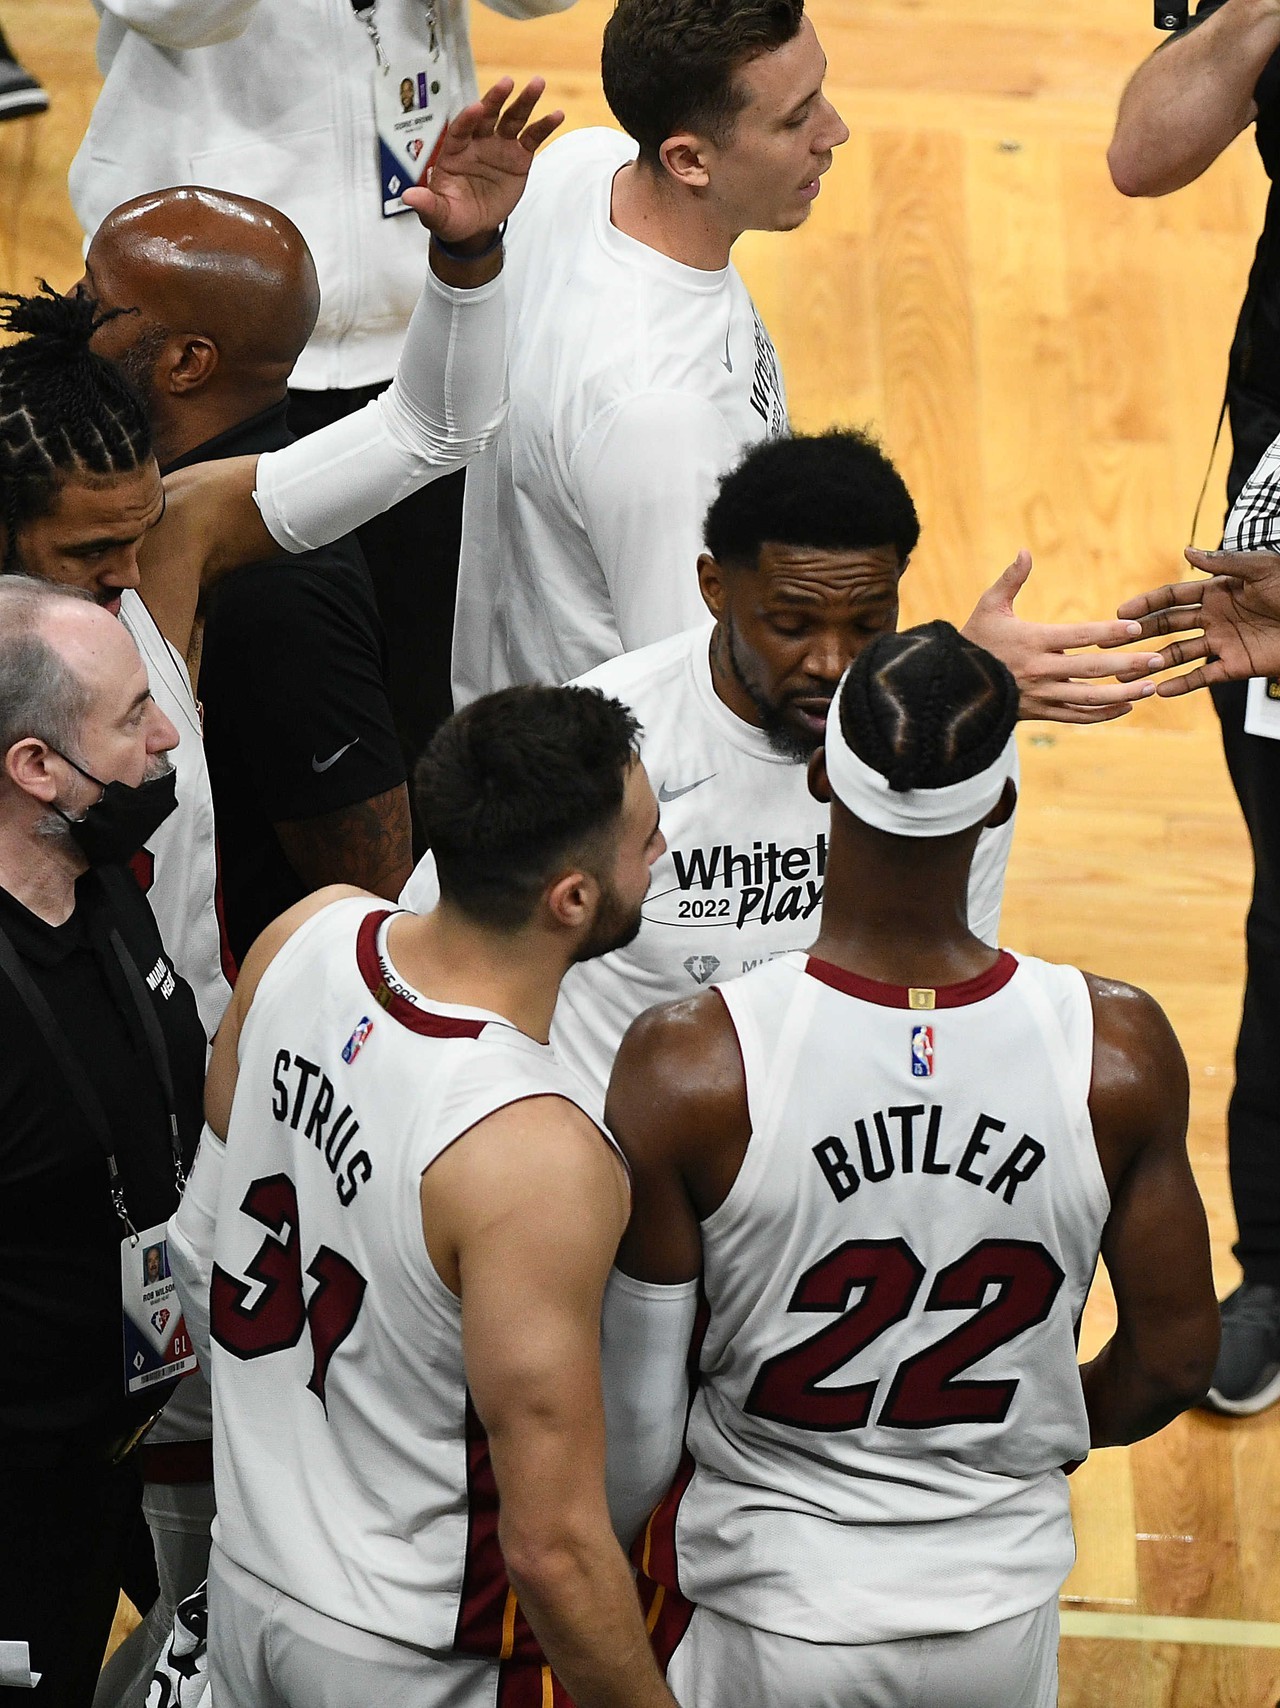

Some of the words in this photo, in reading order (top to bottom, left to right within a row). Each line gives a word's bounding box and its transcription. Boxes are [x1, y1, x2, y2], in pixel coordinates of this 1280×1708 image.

[678, 899, 730, 918] 2022
[272, 1048, 373, 1207] STRUS
[811, 1104, 1046, 1204] BUTLER
[209, 1172, 368, 1422] 31
[742, 1237, 1066, 1432] 22
